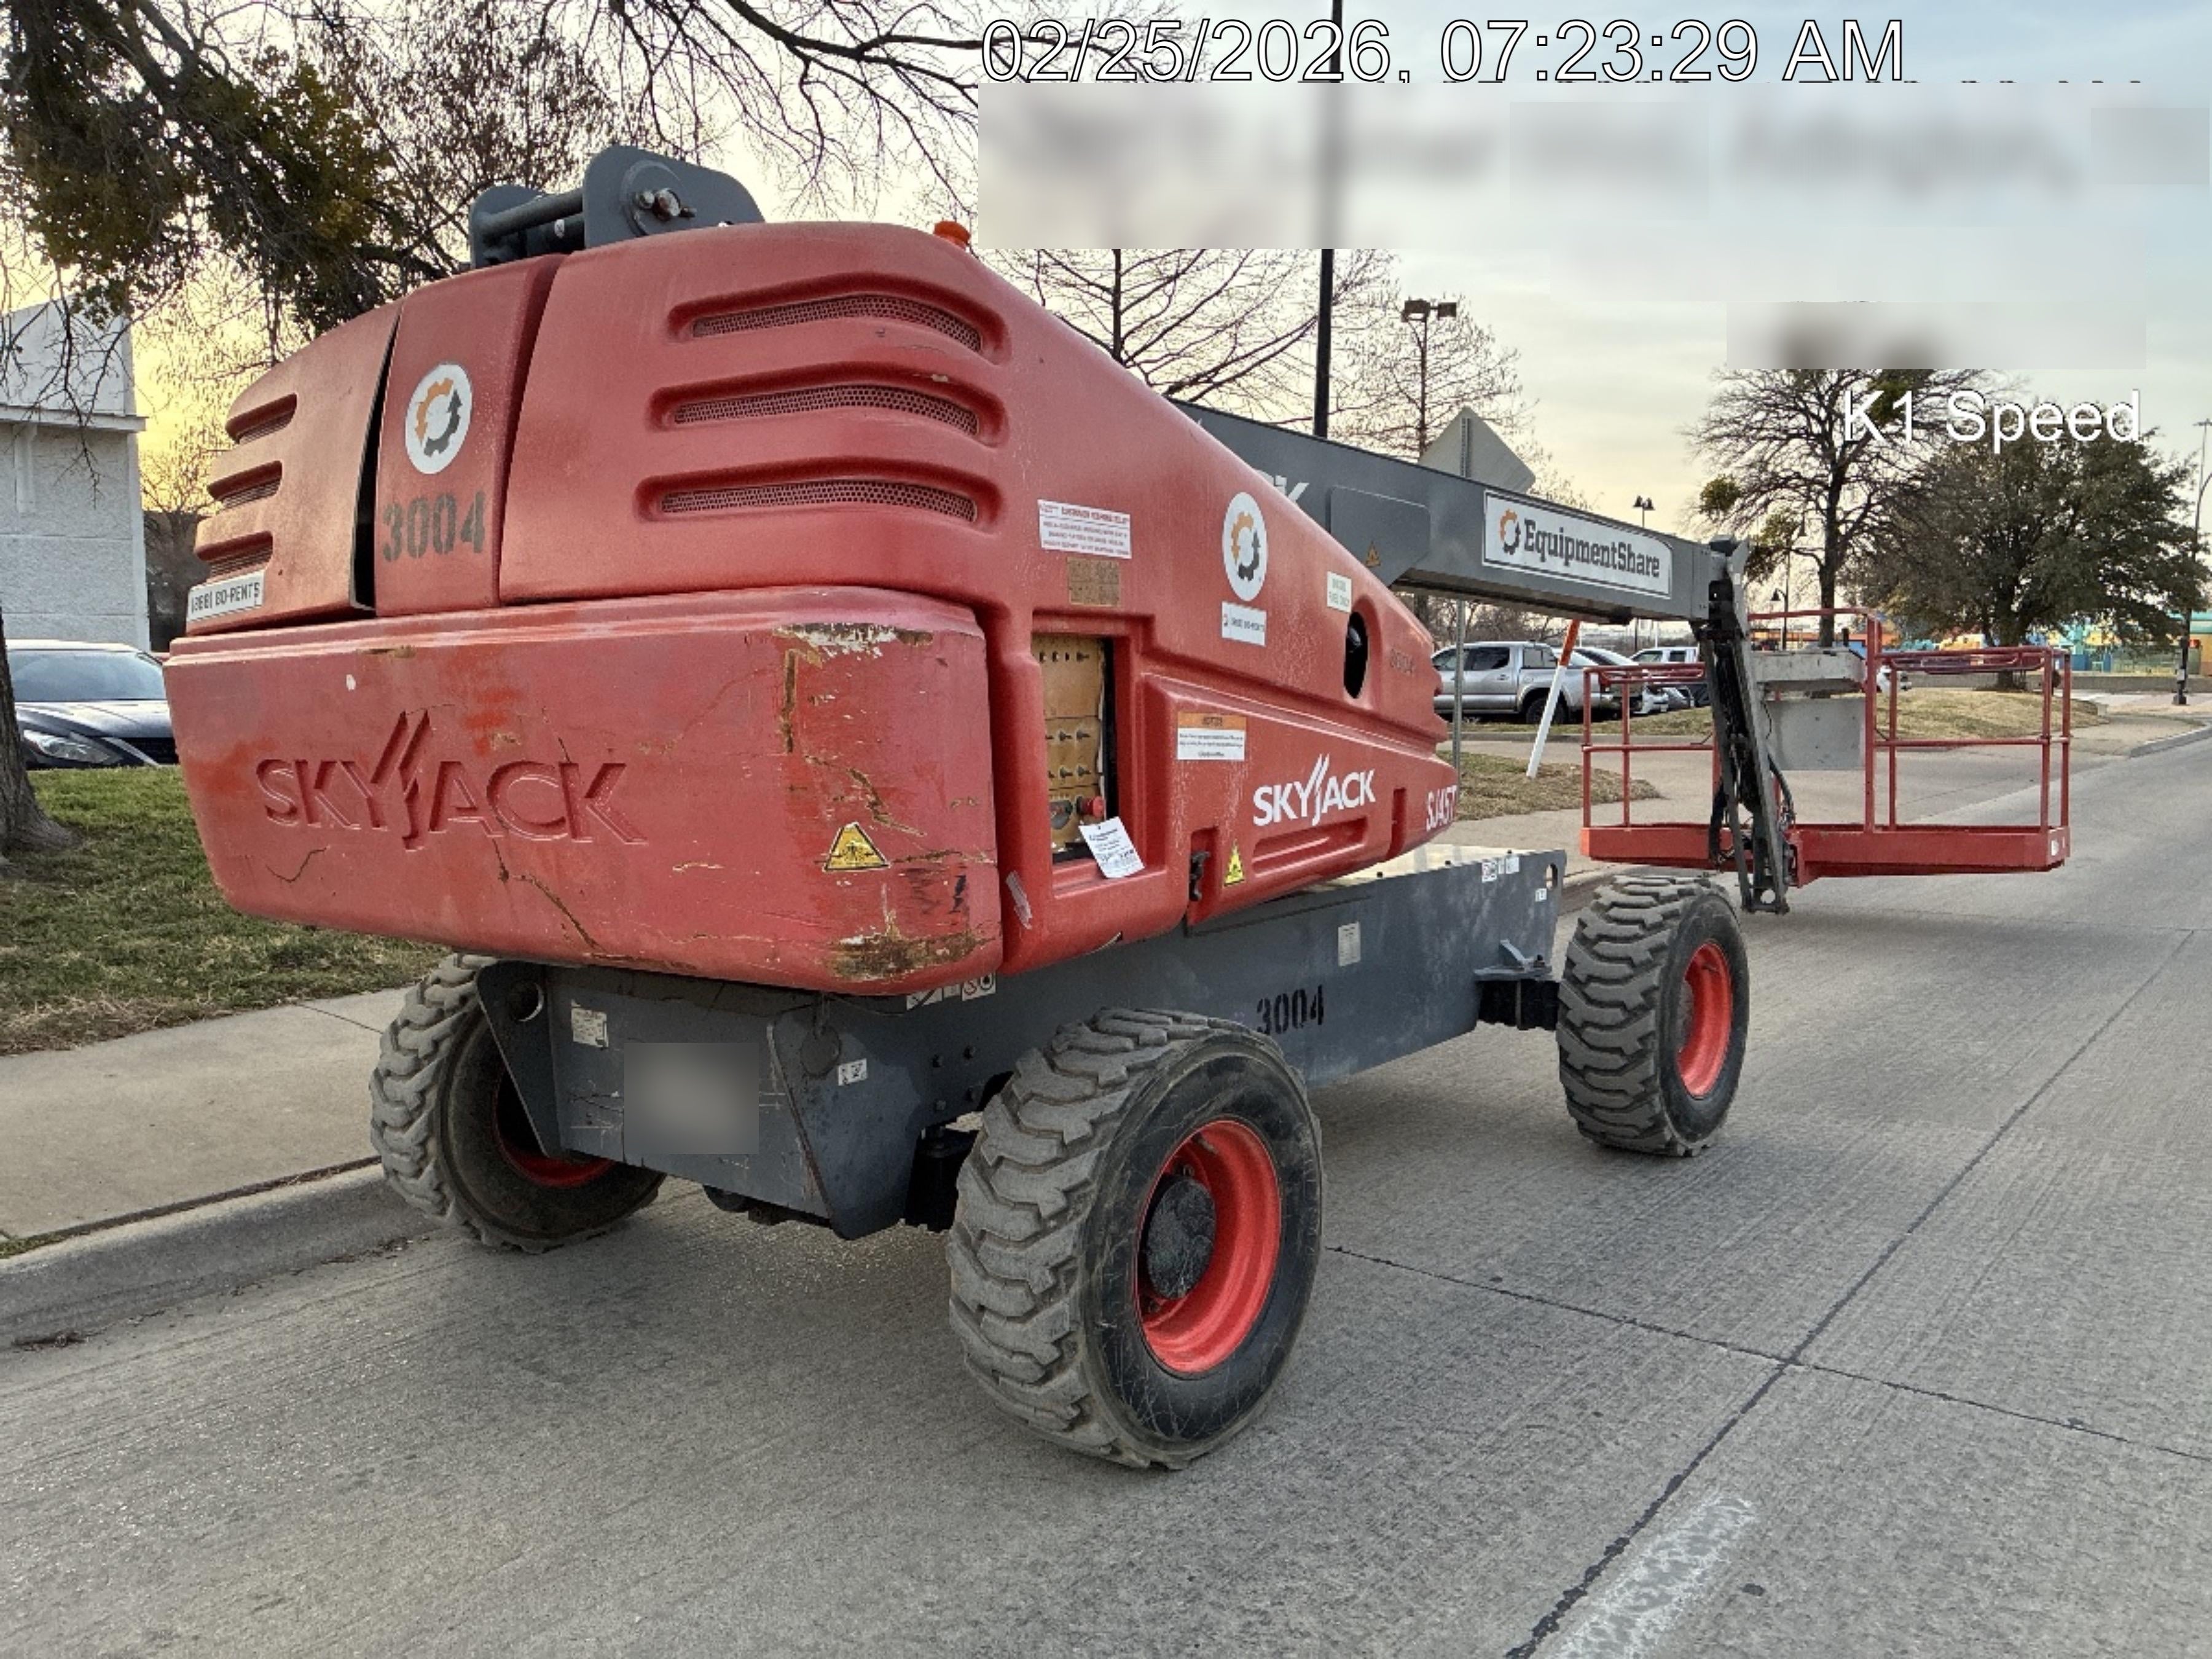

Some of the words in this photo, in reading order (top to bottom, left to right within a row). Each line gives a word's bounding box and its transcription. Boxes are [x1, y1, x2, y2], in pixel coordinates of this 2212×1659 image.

[383, 490, 485, 562] 3004
[1524, 517, 1660, 578] EquipmentShare
[256, 710, 648, 853] SKYJACK
[1252, 753, 1376, 827] SKYJACK
[1257, 984, 1324, 1035] 3004
